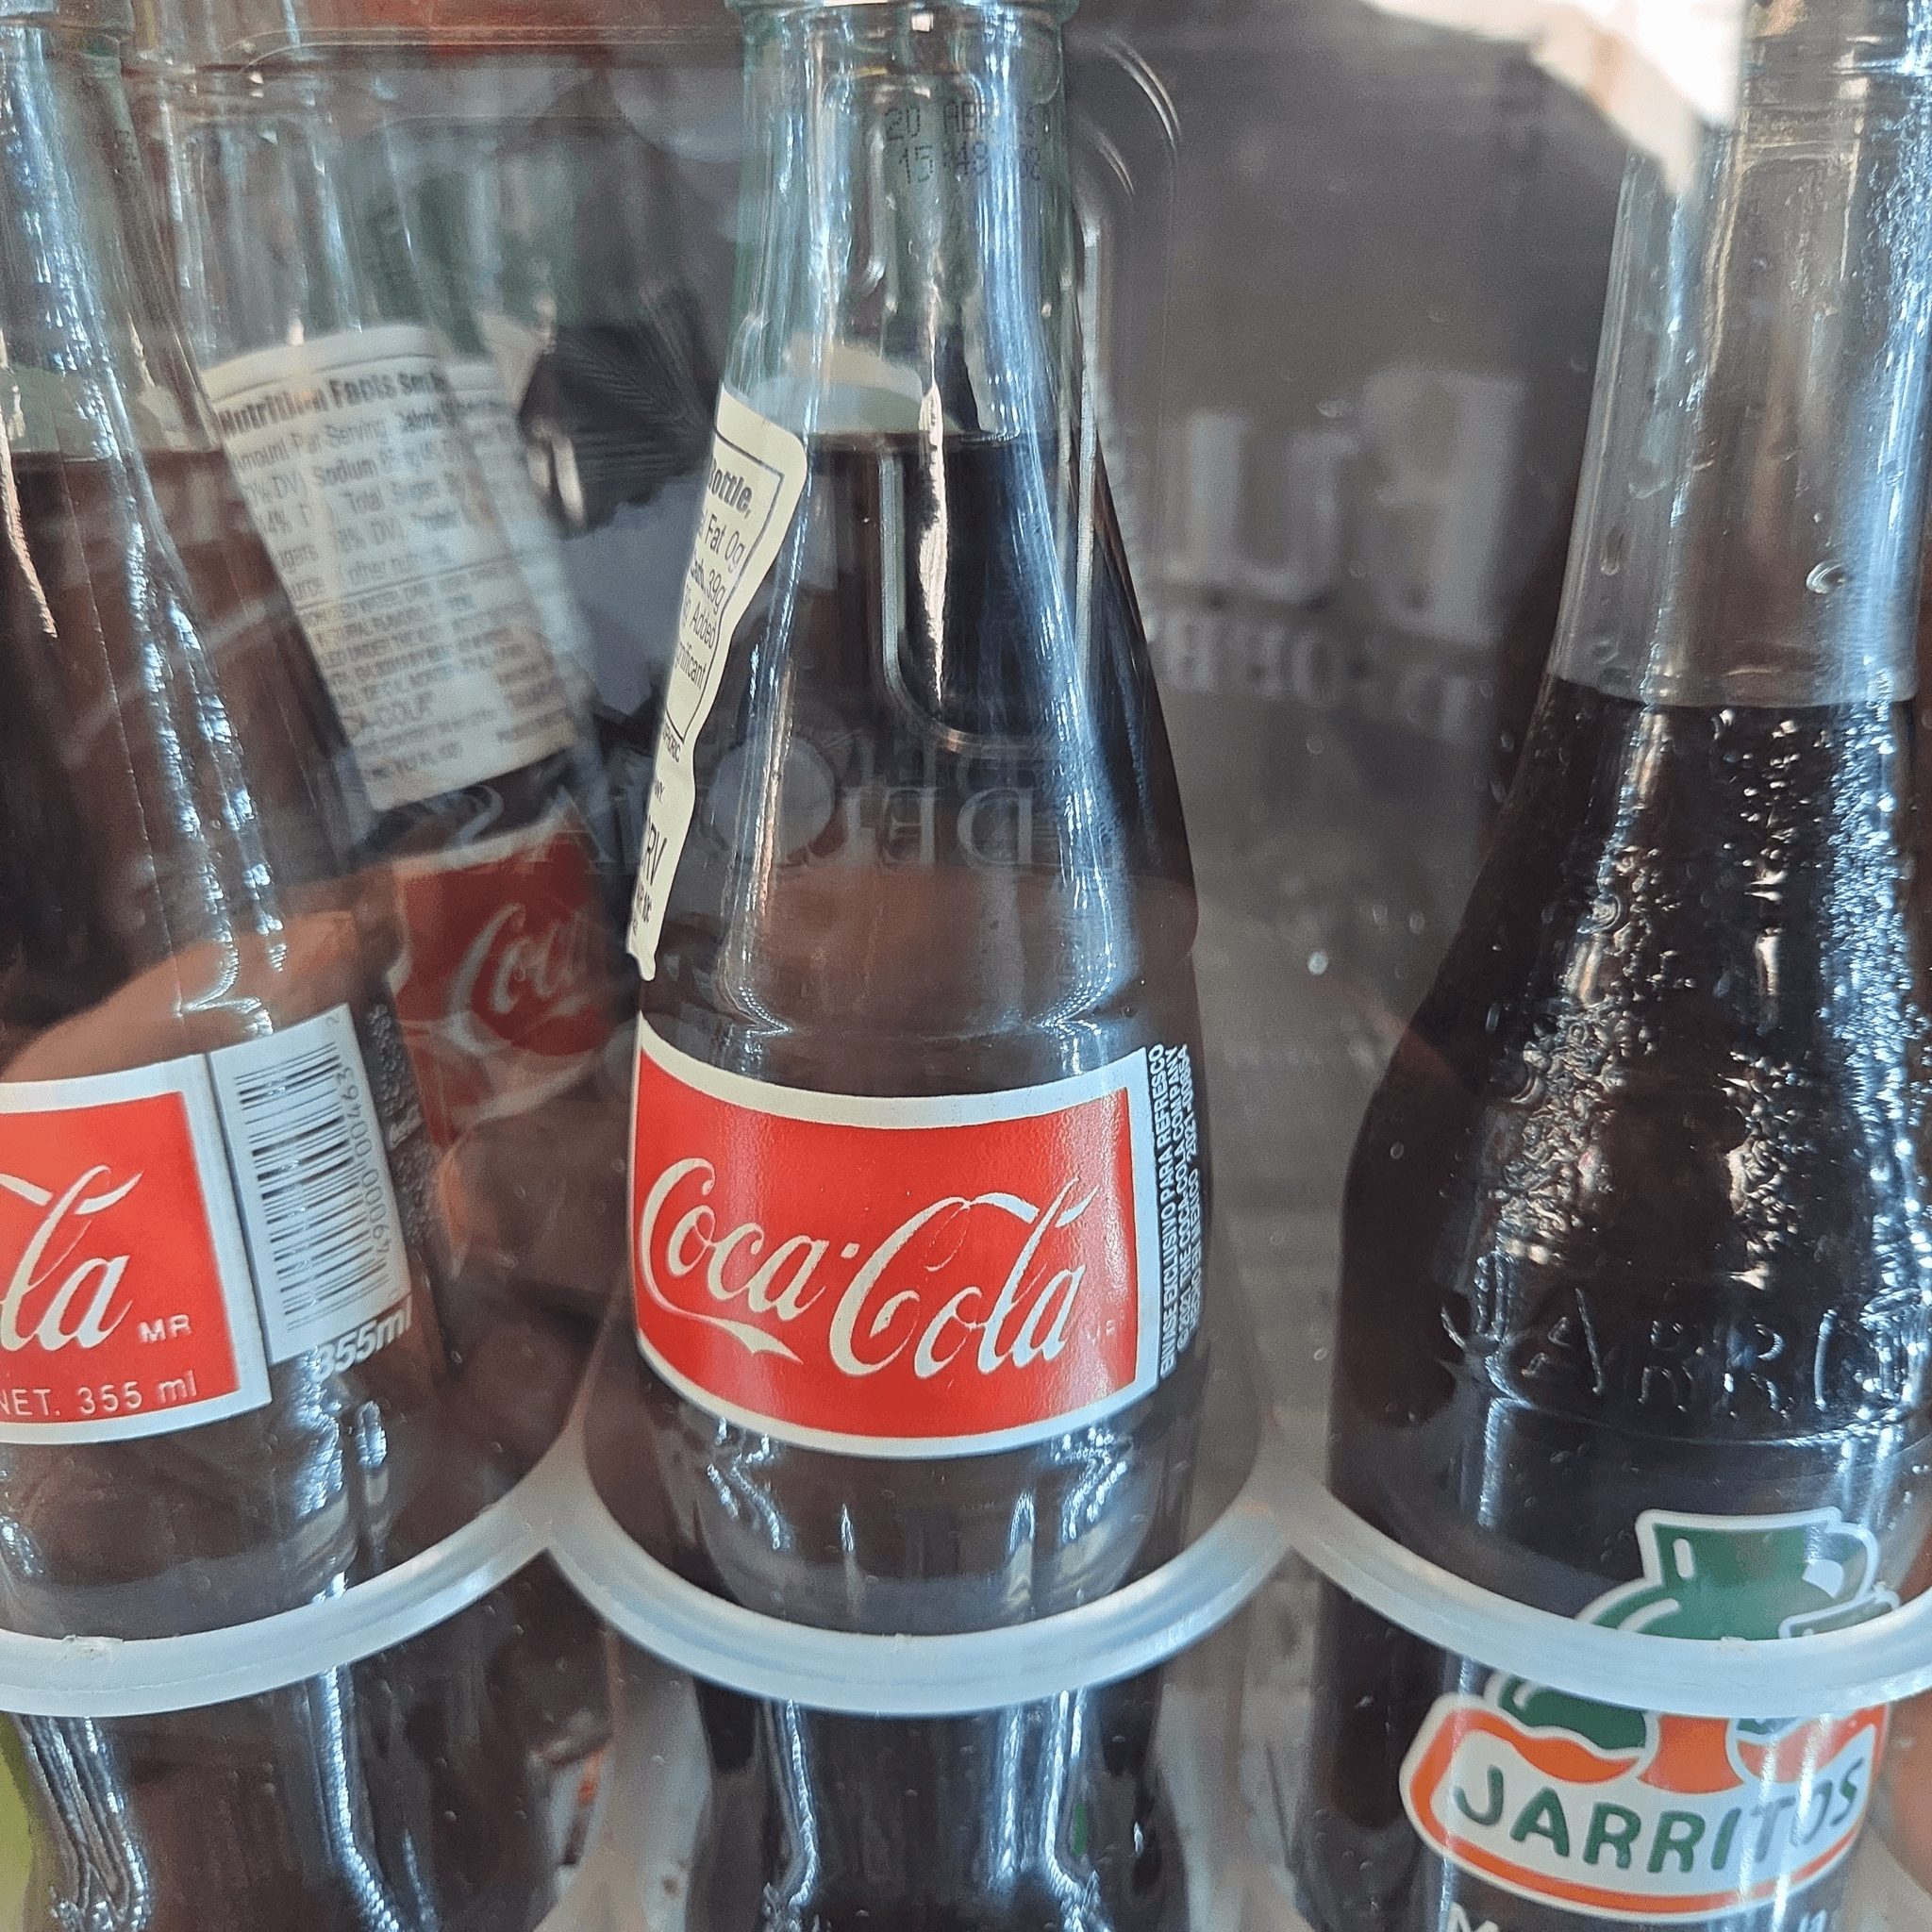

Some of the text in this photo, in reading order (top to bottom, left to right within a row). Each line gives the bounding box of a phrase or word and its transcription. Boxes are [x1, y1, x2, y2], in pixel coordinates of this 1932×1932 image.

[705, 513, 726, 556] Fat
[690, 604, 716, 650] Added
[334, 1064, 374, 1158] 00463
[1165, 1045, 1185, 1141] COMPANY
[1148, 1043, 1178, 1380] ENVASE EXCLUSIVO PARA REFRESCO
[1174, 1140, 1191, 1250] COCA-COLA
[640, 1157, 1100, 1380] Coca-Cola
[139, 1314, 193, 1343] MR
[313, 1293, 412, 1381] 355ml
[77, 1380, 142, 1415] 355
[158, 1368, 198, 1404] ml
[1455, 1757, 1864, 1874] JARRITOS
